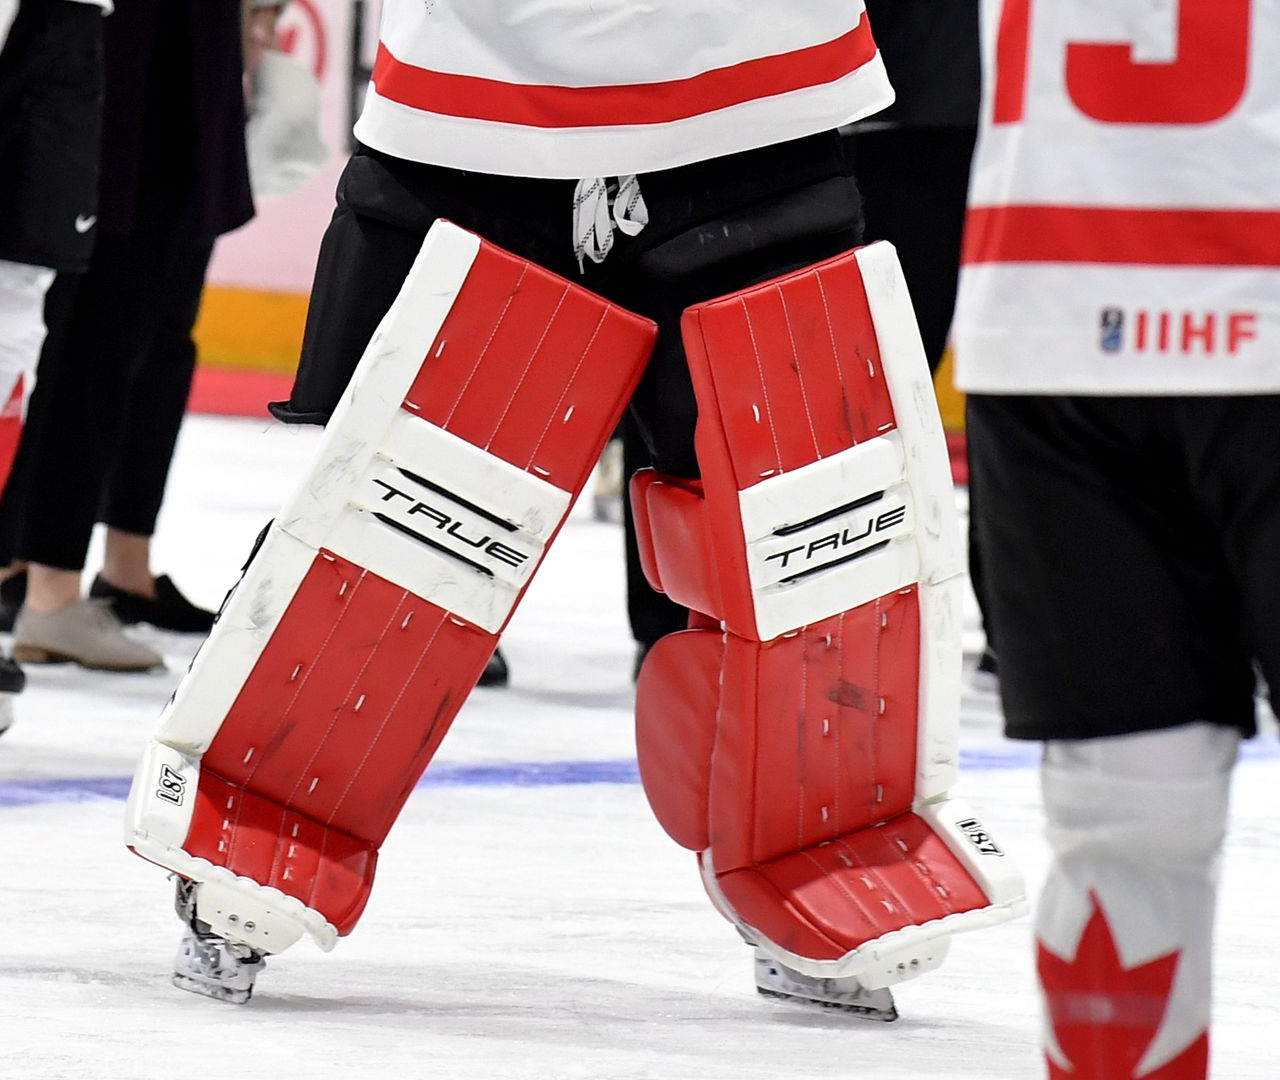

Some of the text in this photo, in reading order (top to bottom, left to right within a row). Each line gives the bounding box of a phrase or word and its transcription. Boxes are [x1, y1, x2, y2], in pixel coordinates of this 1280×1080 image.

[1133, 310, 1256, 356] IIHF
[372, 478, 529, 568] TRUE
[764, 505, 906, 568] TRUE
